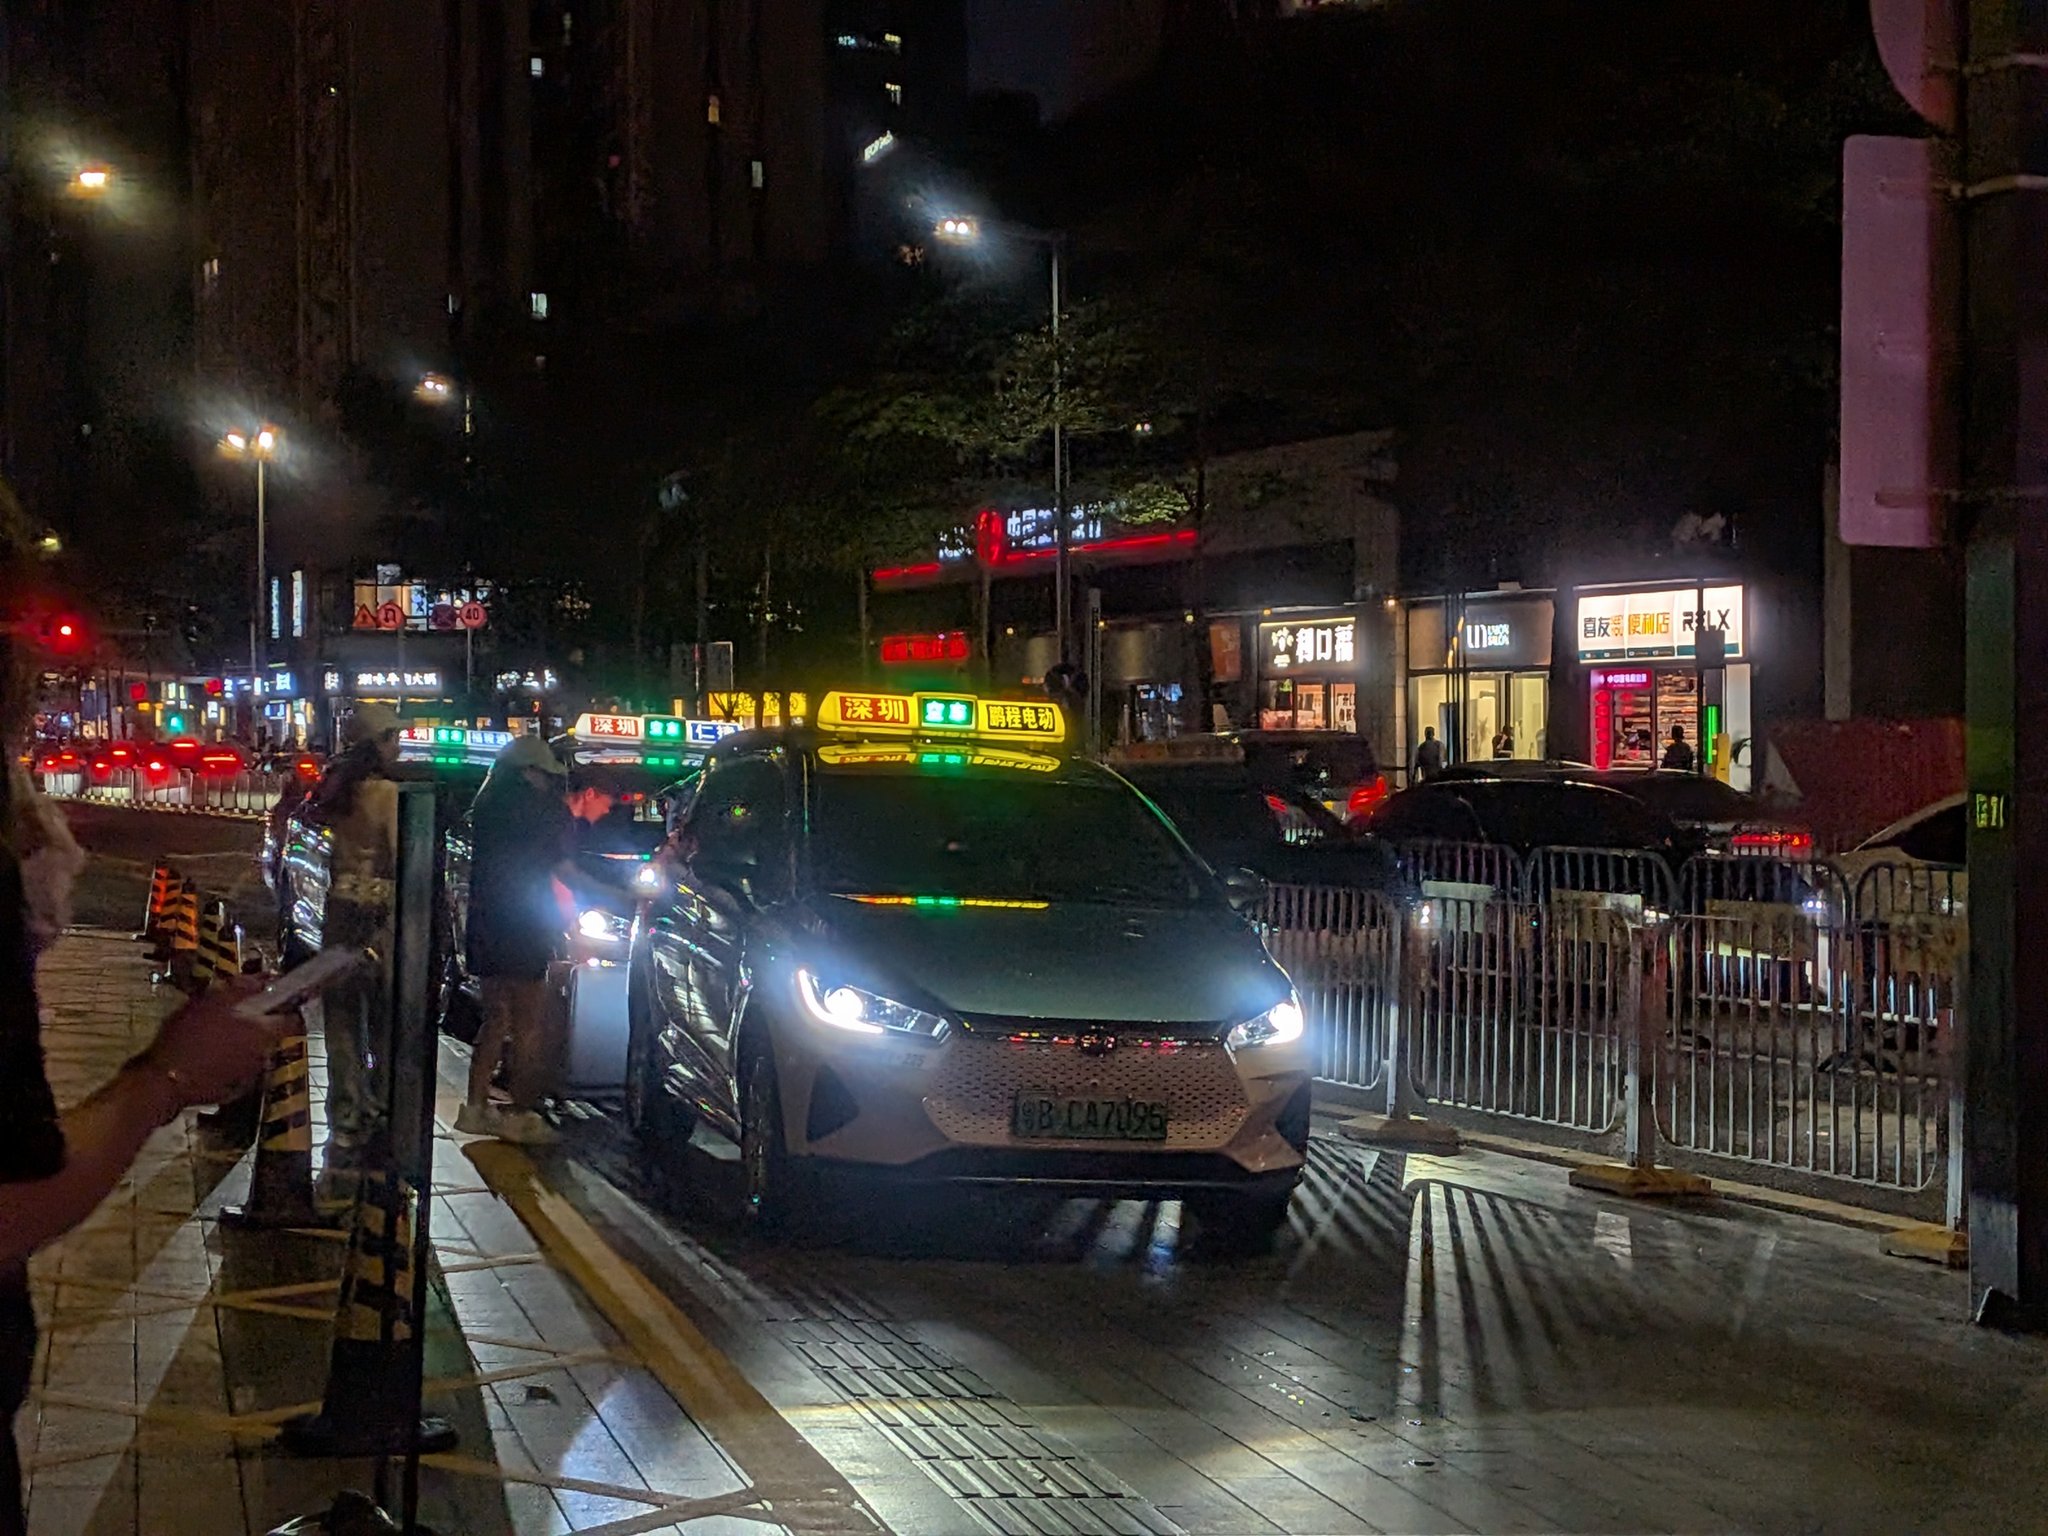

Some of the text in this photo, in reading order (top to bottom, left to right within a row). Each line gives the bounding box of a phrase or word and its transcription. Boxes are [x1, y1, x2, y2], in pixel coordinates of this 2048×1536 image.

[466, 608, 479, 621] 40
[845, 697, 905, 722] 深圳
[988, 705, 1054, 730] 鹏程电动
[594, 717, 637, 736] 深圳
